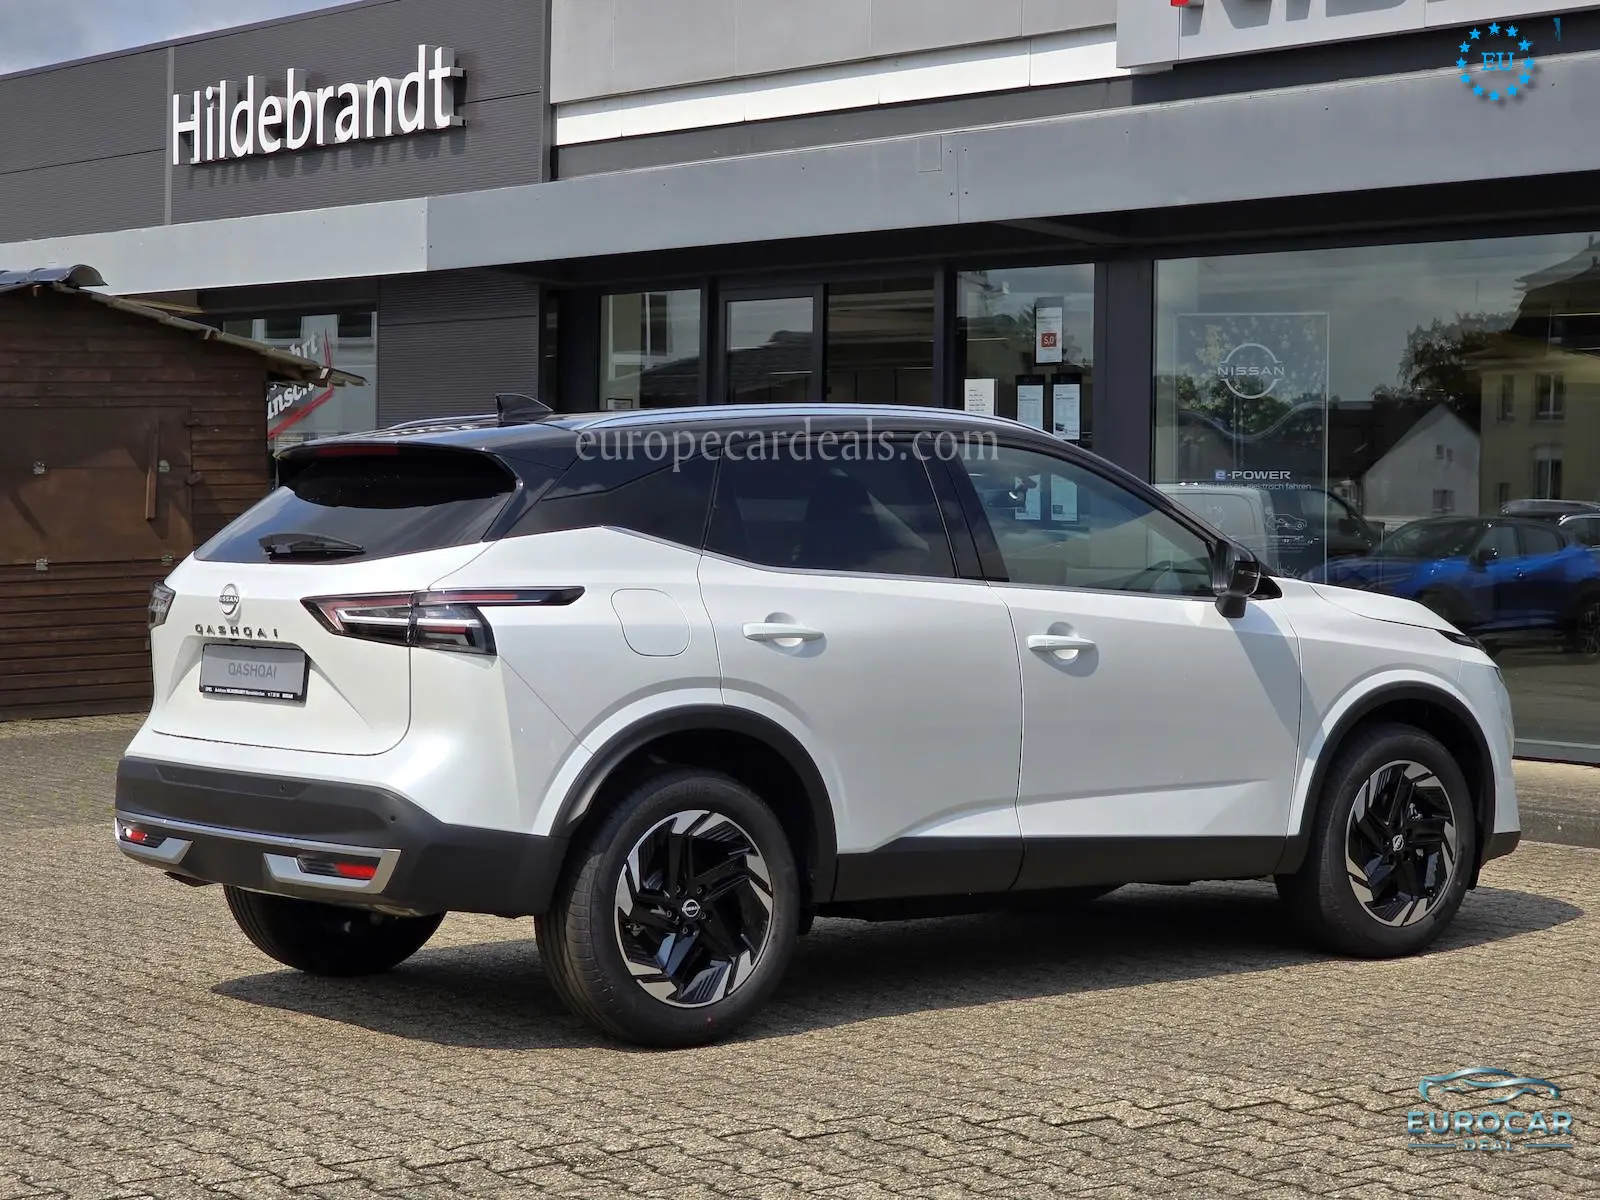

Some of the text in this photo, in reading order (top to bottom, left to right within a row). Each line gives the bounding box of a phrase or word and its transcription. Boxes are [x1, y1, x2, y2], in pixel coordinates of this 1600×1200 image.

[172, 44, 460, 165] Hildebrandt
[1217, 366, 1285, 376] NISSAN
[1215, 470, 1291, 480] e-POWER
[1286, 481, 1312, 491] fahren
[195, 624, 278, 639] QASHQAI
[228, 662, 277, 680] QASHQAI
